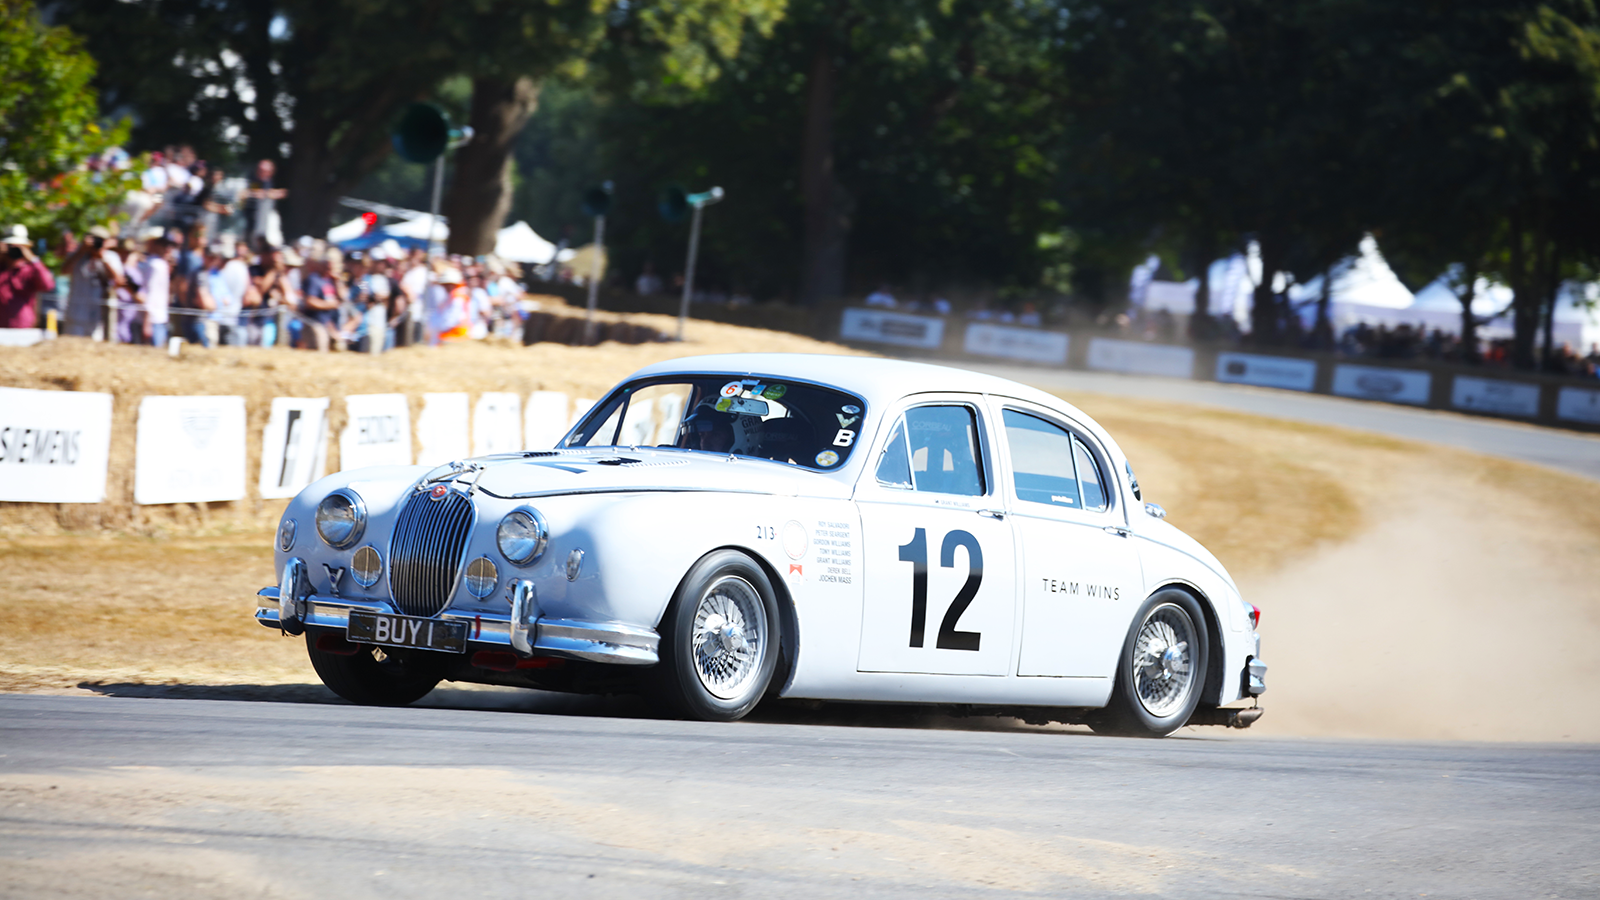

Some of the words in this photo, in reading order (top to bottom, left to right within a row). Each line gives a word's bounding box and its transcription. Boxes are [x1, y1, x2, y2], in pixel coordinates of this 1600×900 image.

[726, 384, 738, 394] 6
[832, 429, 856, 447] B
[0, 427, 81, 465] SIEMENS
[756, 526, 774, 540] 213
[814, 538, 830, 546] GORDON
[831, 540, 851, 548] WILLIAMS
[831, 549, 851, 557] WILLIAMS
[816, 556, 830, 564] GRANT
[832, 558, 852, 566] WILLIAMS
[828, 566, 840, 574] DEREK
[818, 574, 837, 583] JOCHEN
[838, 576, 852, 584] MASS
[898, 527, 984, 652] 12
[1042, 578, 1080, 596] TEAM
[1086, 584, 1120, 600] WINS
[375, 616, 422, 645] BUY
